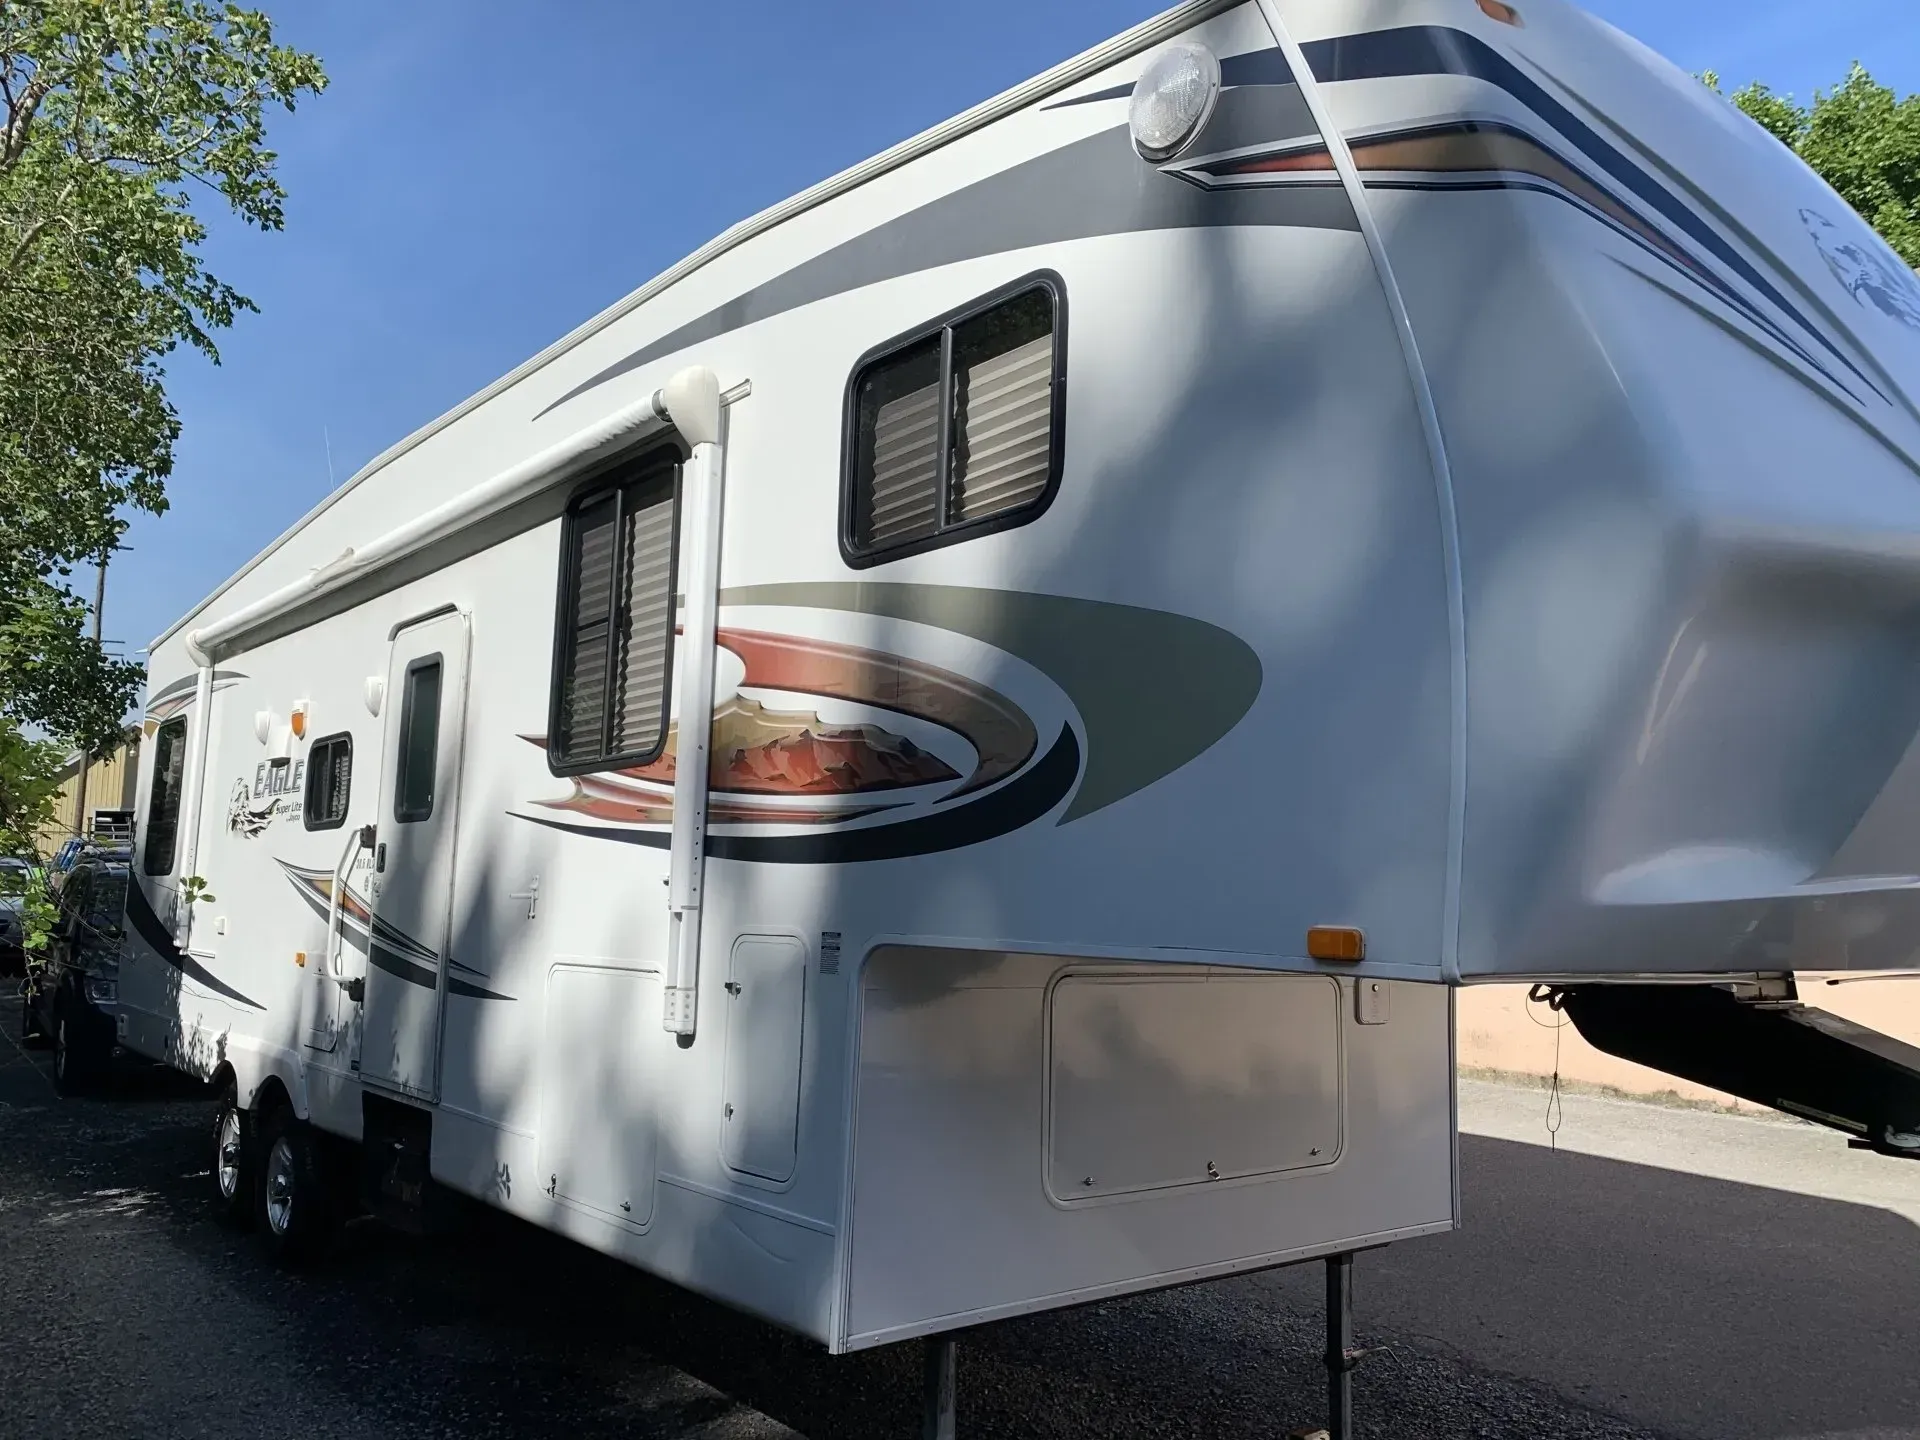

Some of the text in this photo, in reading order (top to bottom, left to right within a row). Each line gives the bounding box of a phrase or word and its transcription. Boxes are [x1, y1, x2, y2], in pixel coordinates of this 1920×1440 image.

[254, 759, 304, 799] EAGLE
[275, 801, 303, 816] Super Lite
